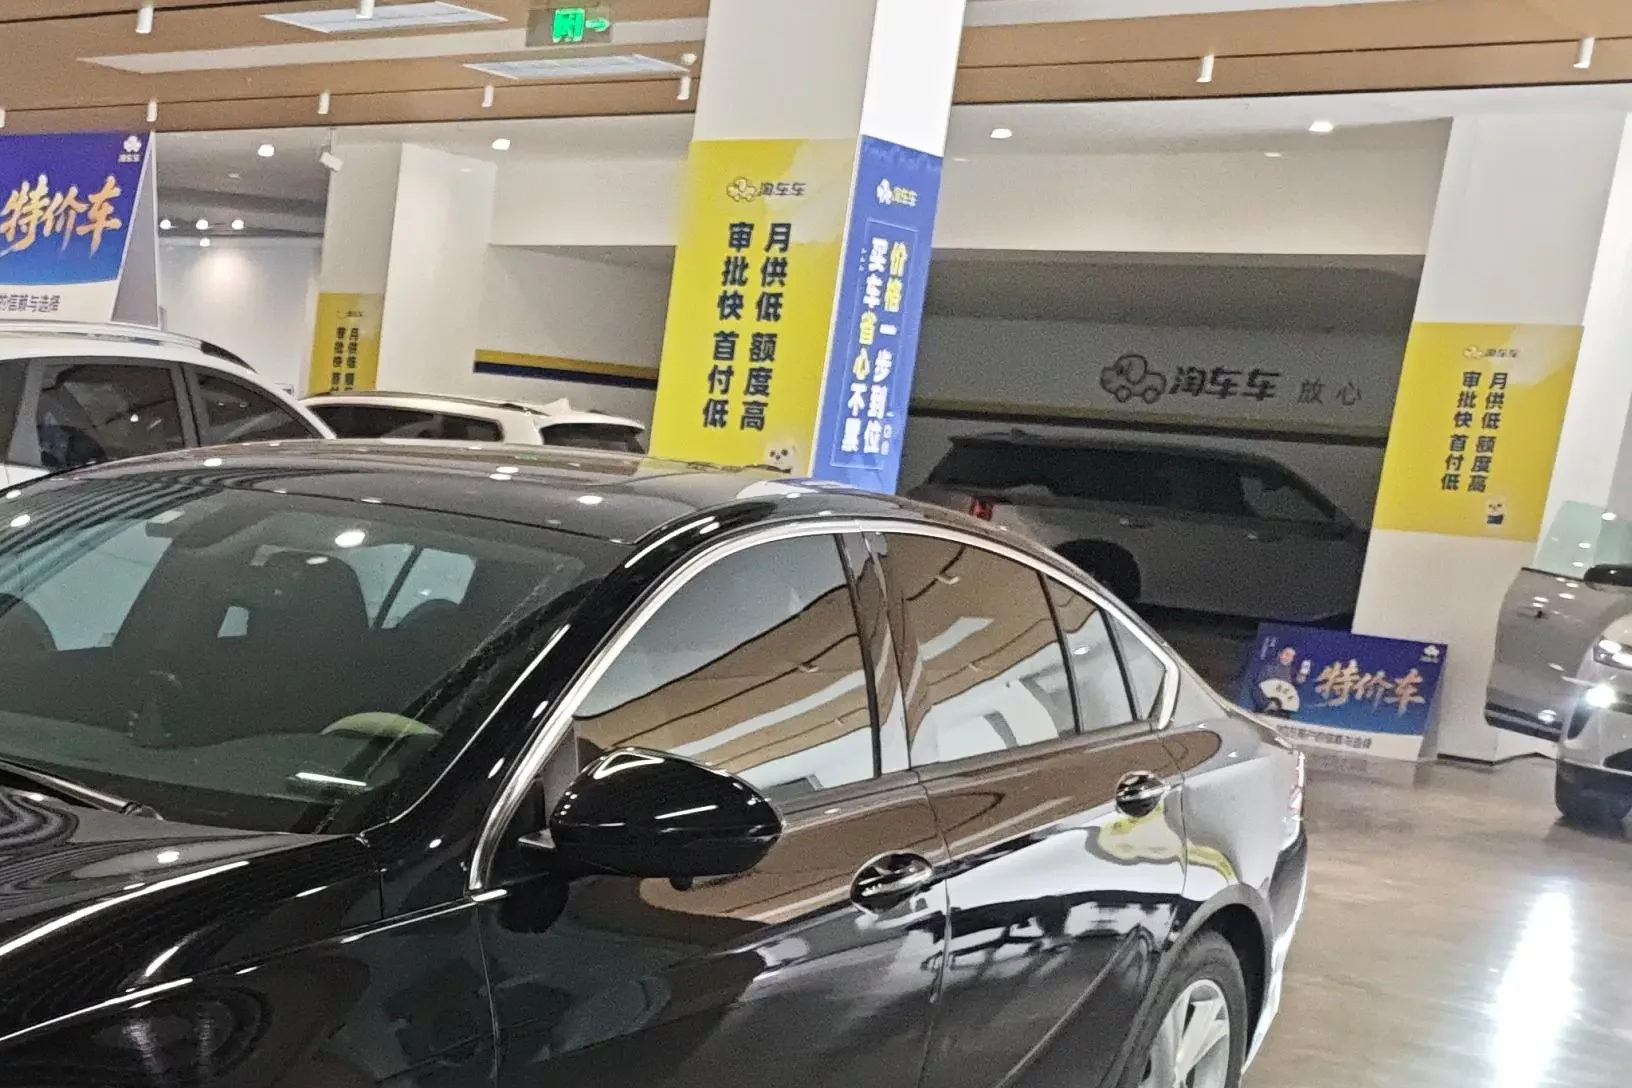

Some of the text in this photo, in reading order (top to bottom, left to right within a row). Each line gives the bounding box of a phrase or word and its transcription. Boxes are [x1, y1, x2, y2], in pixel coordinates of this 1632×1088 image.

[757, 181, 807, 198] 淘车车
[1169, 365, 1362, 406] 淘车车 放心
[1312, 658, 1426, 717] 特价车
